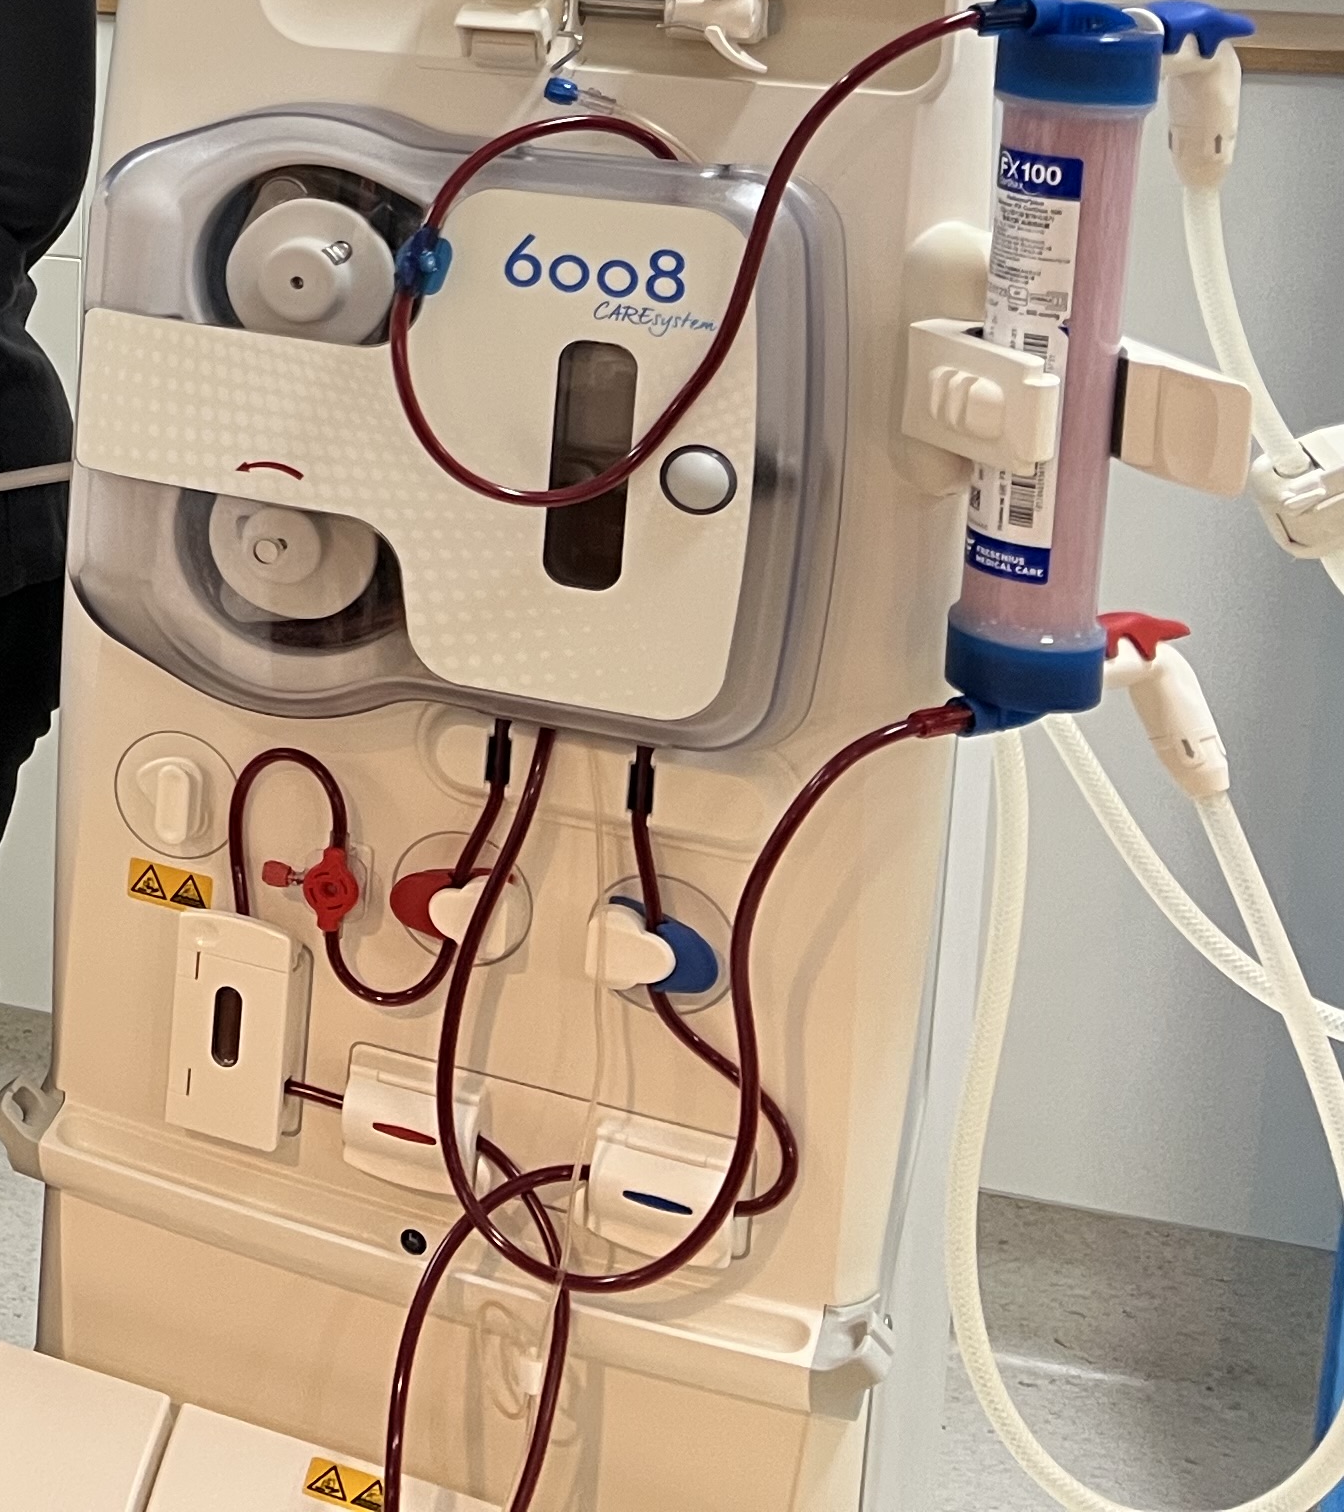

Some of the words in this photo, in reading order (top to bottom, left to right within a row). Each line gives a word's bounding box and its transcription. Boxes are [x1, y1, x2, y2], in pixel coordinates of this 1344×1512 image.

[504, 233, 686, 304] 6008
[593, 300, 717, 338] CAREsystem
[975, 554, 1012, 572] MEDICAL
[1015, 566, 1044, 578] CARE
[976, 545, 1025, 565] FRESENIUS
